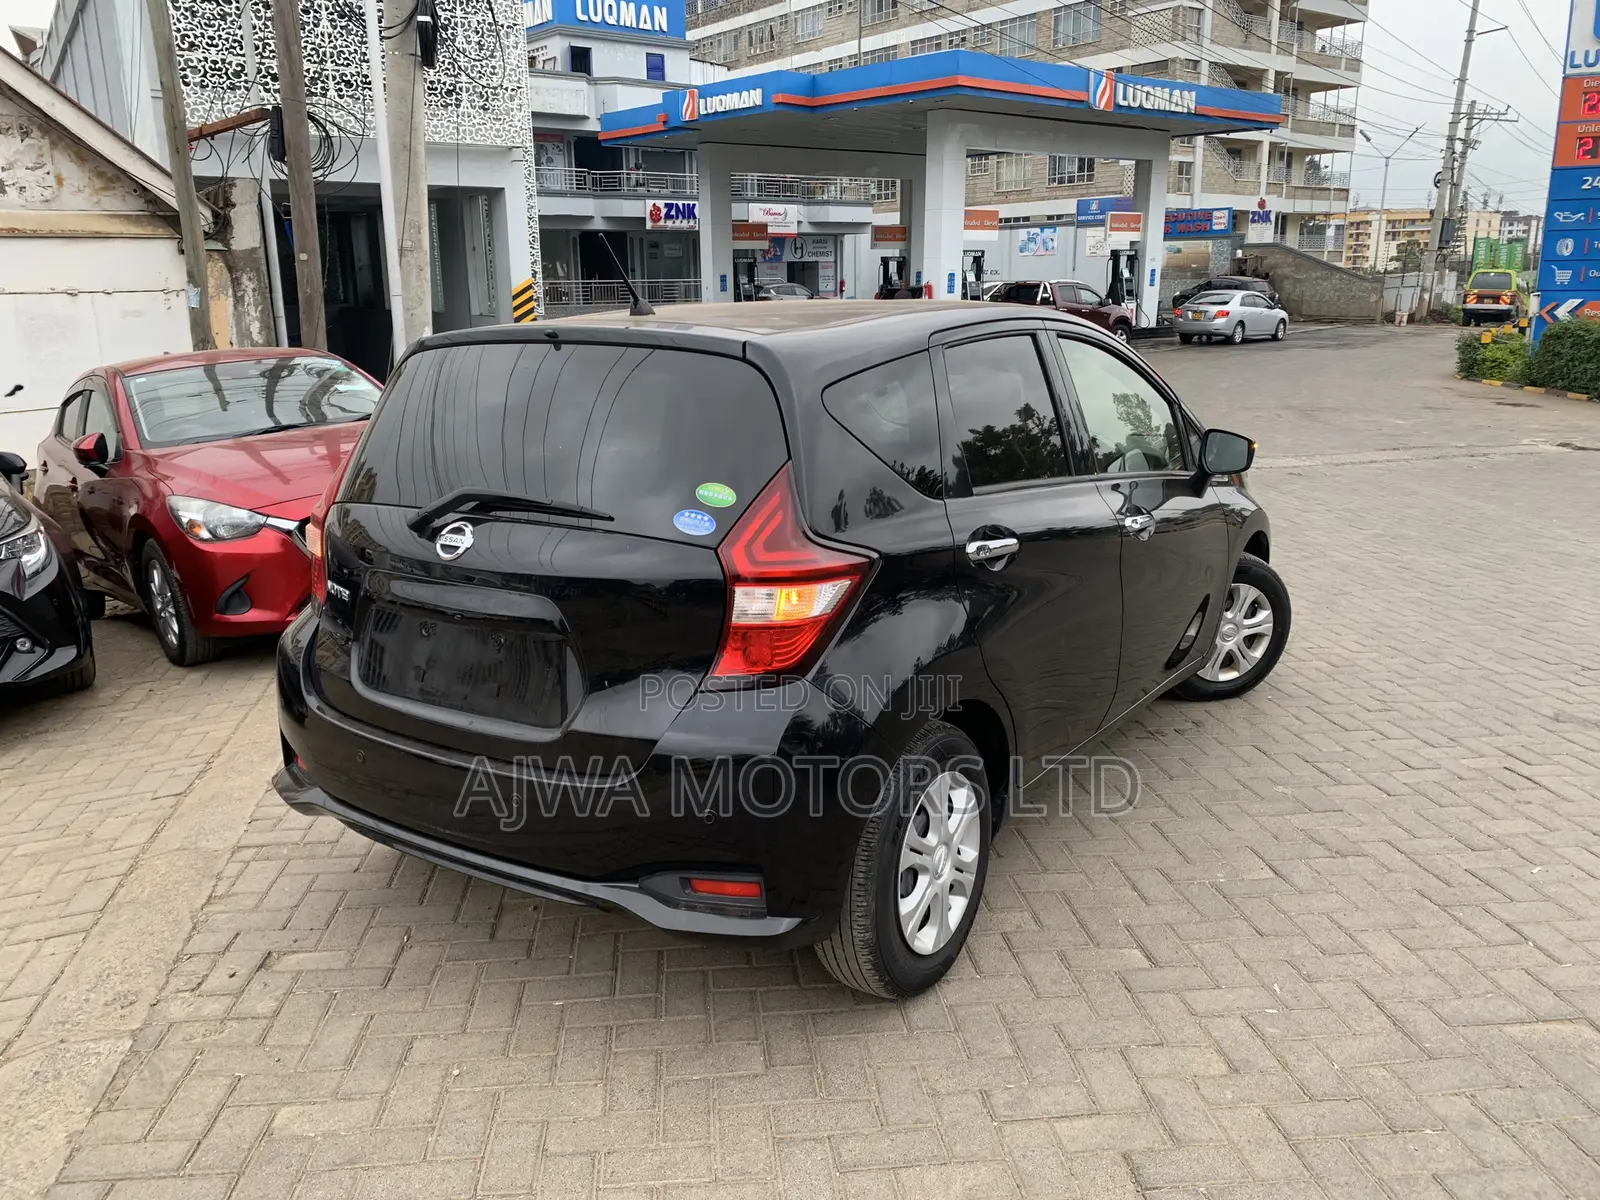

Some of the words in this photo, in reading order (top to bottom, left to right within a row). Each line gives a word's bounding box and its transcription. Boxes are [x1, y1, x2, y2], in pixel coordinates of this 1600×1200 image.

[575, 0, 668, 32] LUQMAN
[700, 88, 762, 115] LUQMAN
[1116, 82, 1196, 114] LUQMAN
[664, 202, 697, 220] ZNK
[1250, 210, 1272, 224] ZNK
[1177, 222, 1210, 233] WASH
[807, 250, 832, 258] CHEMIST
